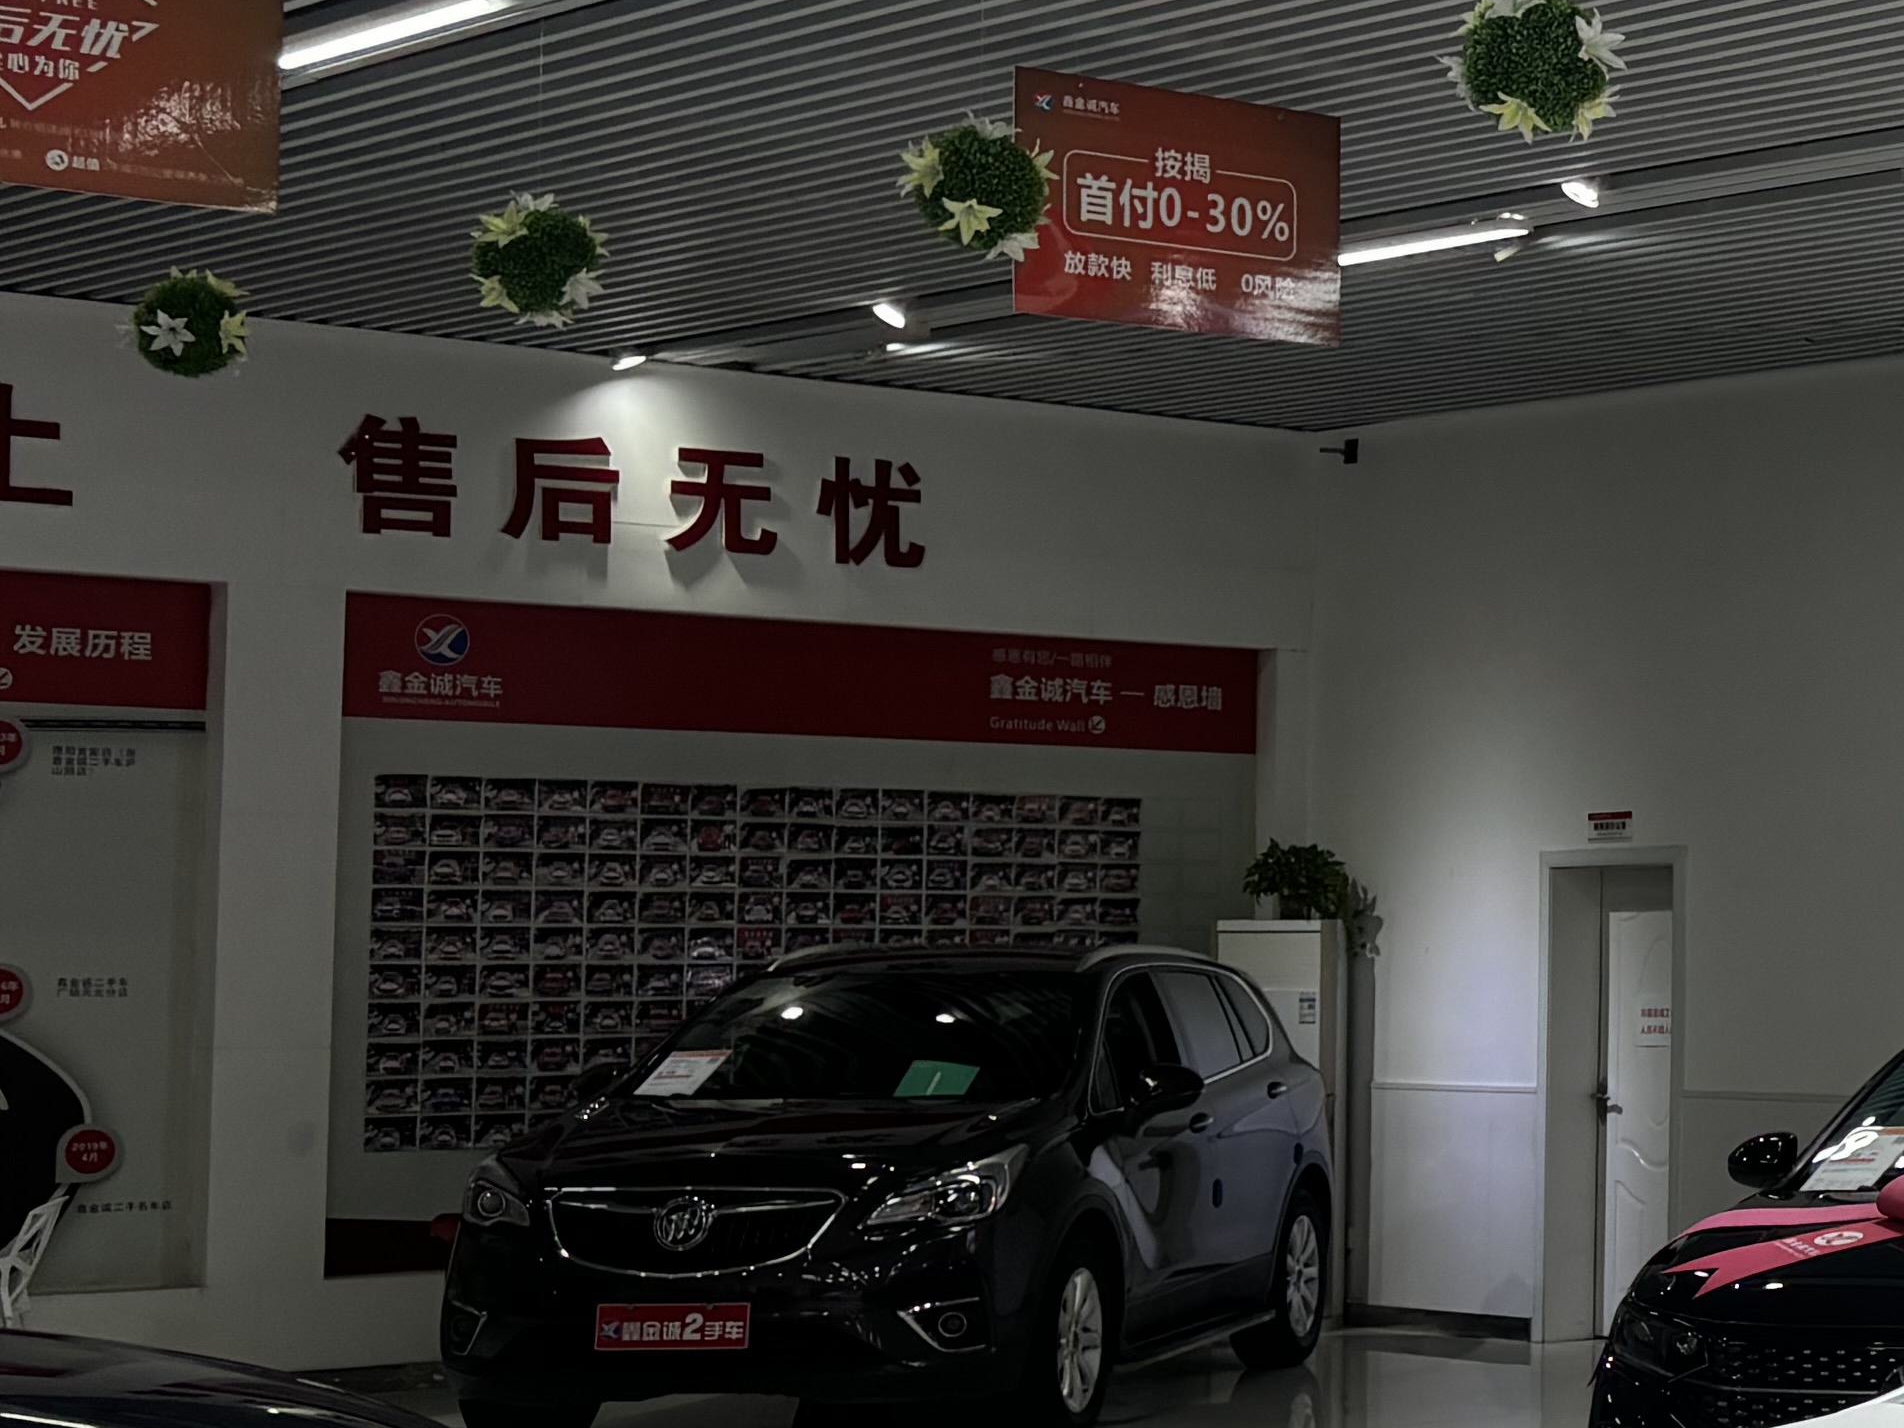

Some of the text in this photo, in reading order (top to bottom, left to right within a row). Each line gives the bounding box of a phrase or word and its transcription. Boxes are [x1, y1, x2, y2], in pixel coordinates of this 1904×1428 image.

[1155, 147, 1211, 183] 按揭
[1077, 173, 1290, 241] 首付0-30%
[1064, 251, 1132, 280] 放款快
[1151, 262, 1217, 291] 利息低
[338, 413, 926, 568] 售后无忧
[14, 624, 153, 661] 发展历程
[378, 670, 503, 698] 鑫金诚汽车
[1154, 684, 1223, 711] 感恩墙
[990, 716, 1086, 732] Gratitude Wall
[622, 1312, 744, 1341] 鑫金诚2手车
